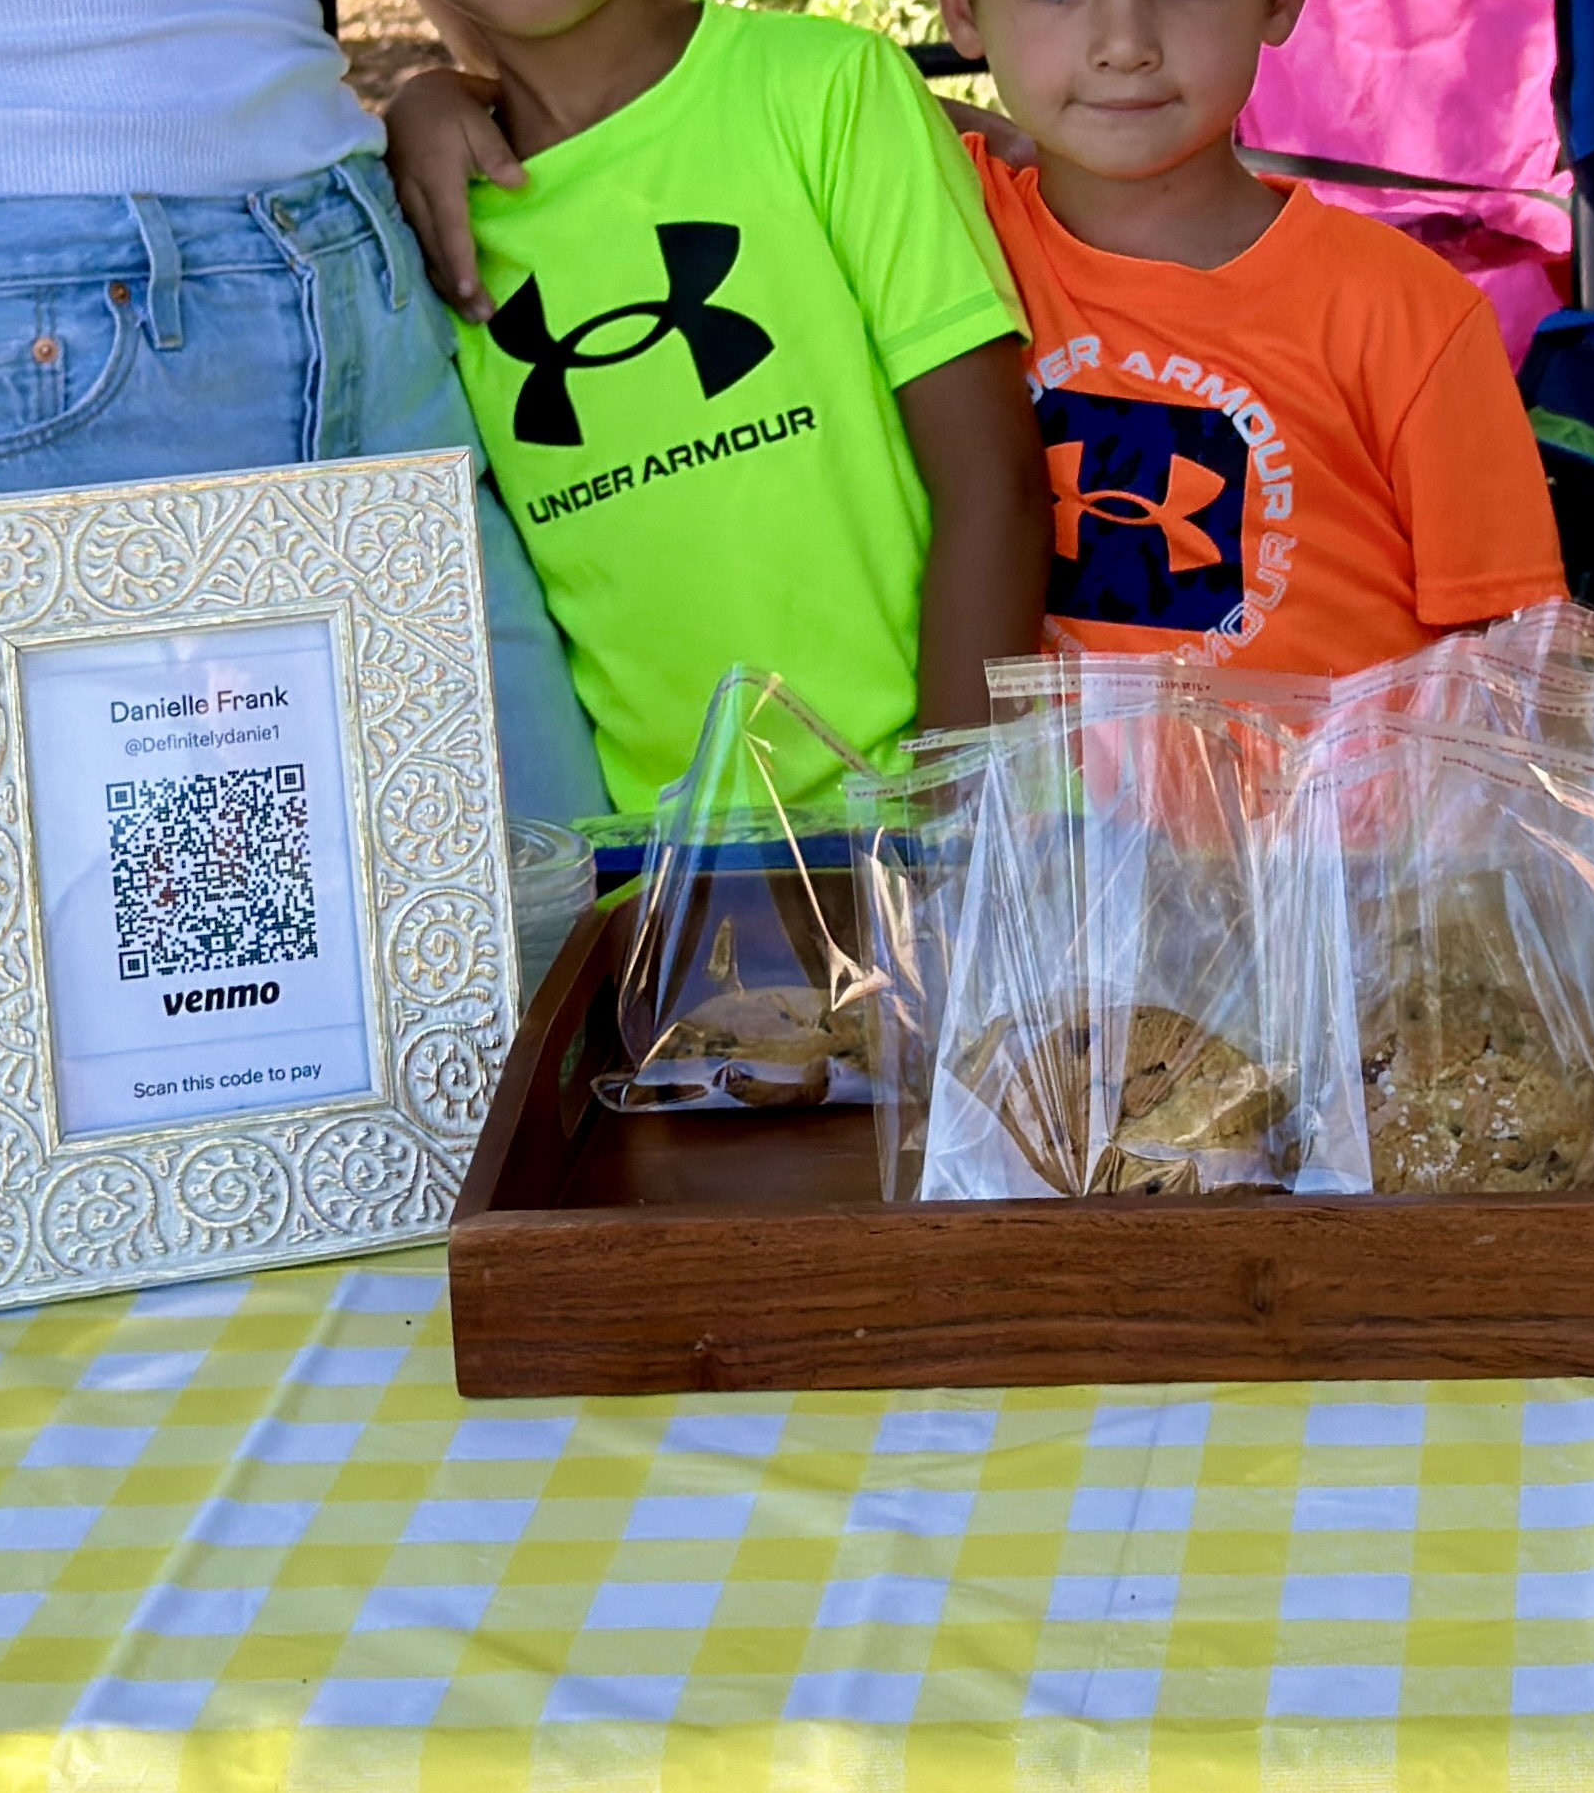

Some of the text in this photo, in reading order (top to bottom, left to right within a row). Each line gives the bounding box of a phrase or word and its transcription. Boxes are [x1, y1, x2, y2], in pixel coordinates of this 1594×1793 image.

[1119, 350, 1293, 521] ARMOUR
[527, 405, 817, 525] UNDER ARMOUR
[110, 684, 289, 724] Danielle Frank
[162, 979, 281, 1017] venmo
[132, 1061, 323, 1100] Scan this code to pay
